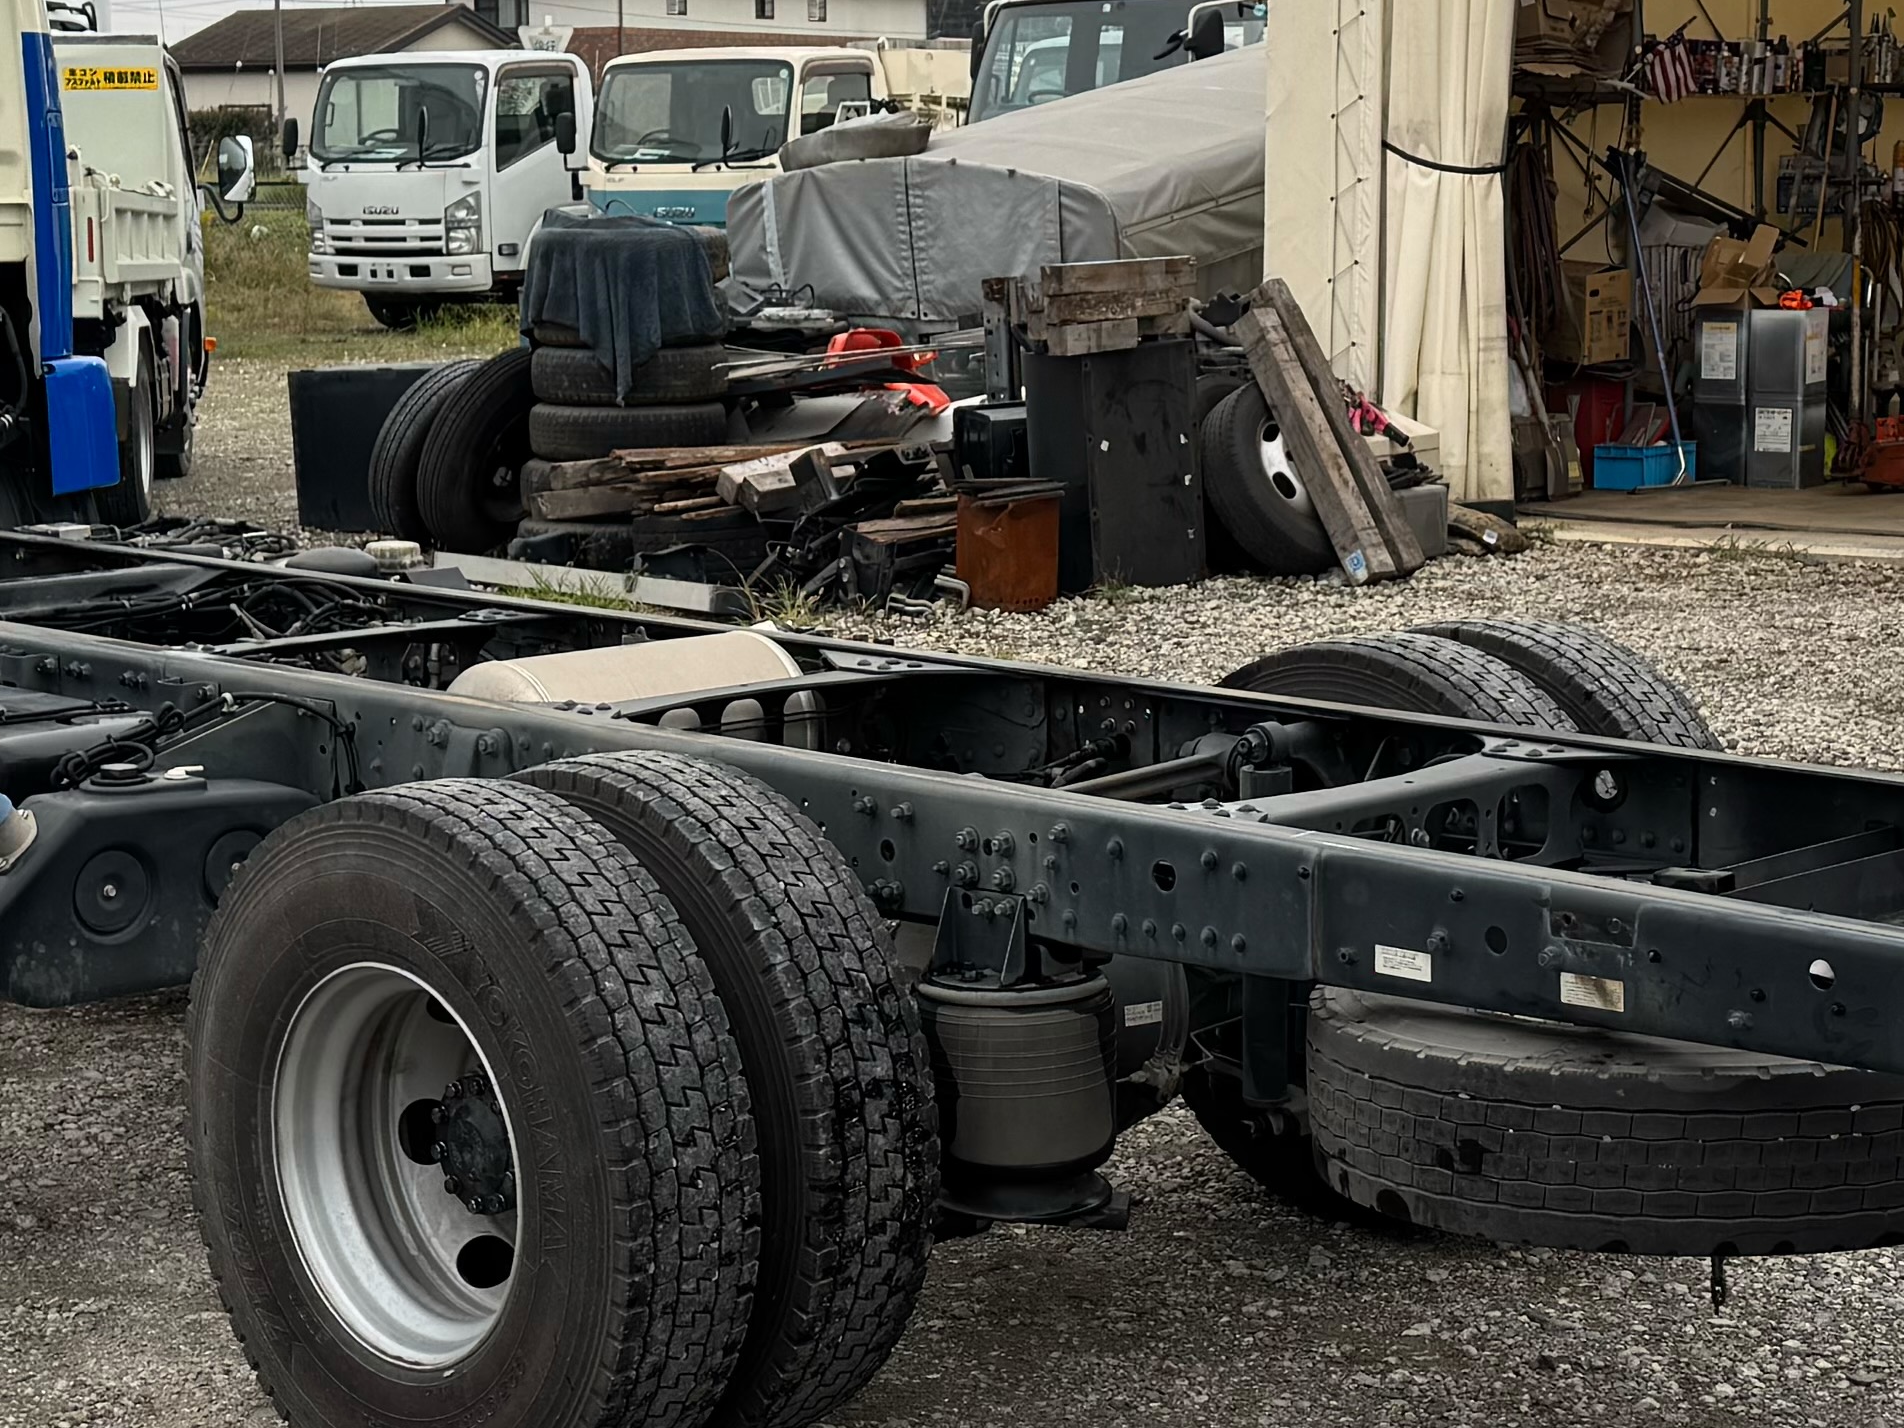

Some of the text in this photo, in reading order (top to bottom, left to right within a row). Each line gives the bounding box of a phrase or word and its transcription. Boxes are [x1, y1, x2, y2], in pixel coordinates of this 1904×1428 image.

[362, 206, 400, 215] ISUZU
[653, 207, 696, 218] ISUZU
[466, 950, 569, 1251] YOKOHAMA
